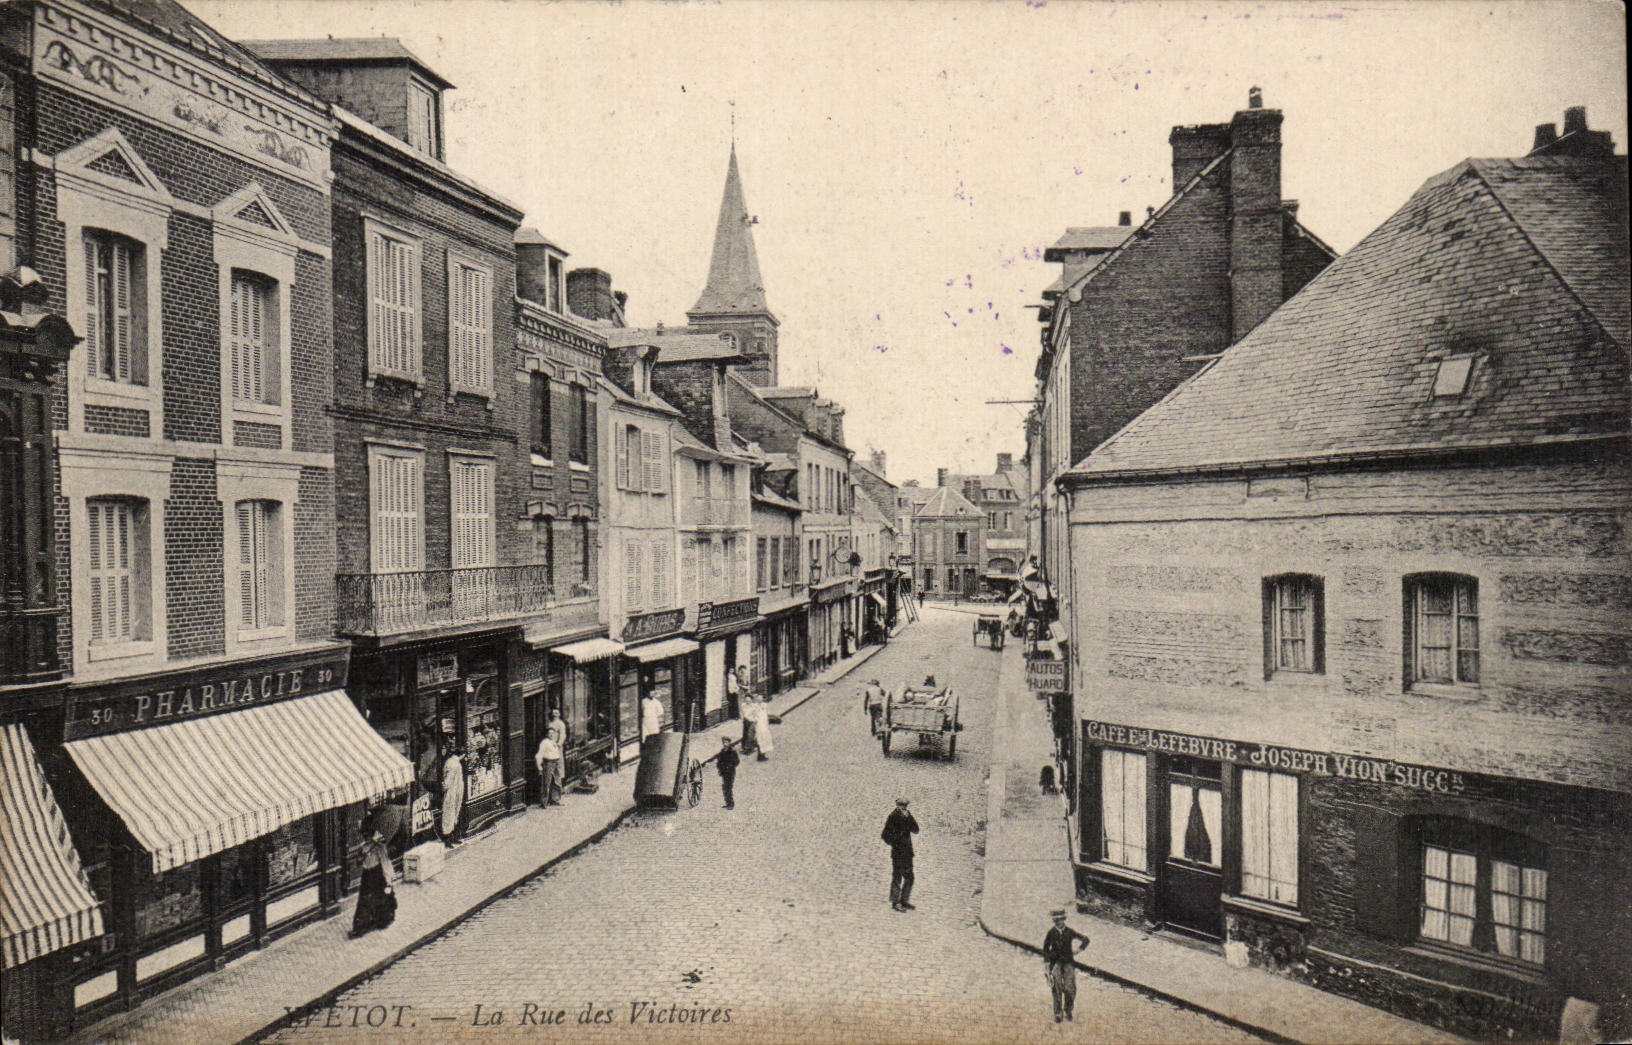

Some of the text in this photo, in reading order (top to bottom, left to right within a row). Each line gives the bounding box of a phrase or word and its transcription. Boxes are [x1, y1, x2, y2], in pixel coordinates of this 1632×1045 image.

[1028, 677, 1063, 690] HUARD
[1029, 662, 1063, 675] AUTOS
[91, 668, 333, 726] 30 PHARMACIE 30
[1146, 729, 1238, 761] LEFEBVRE
[1250, 744, 1329, 776] JOSEPH
[1332, 753, 1387, 783] VION
